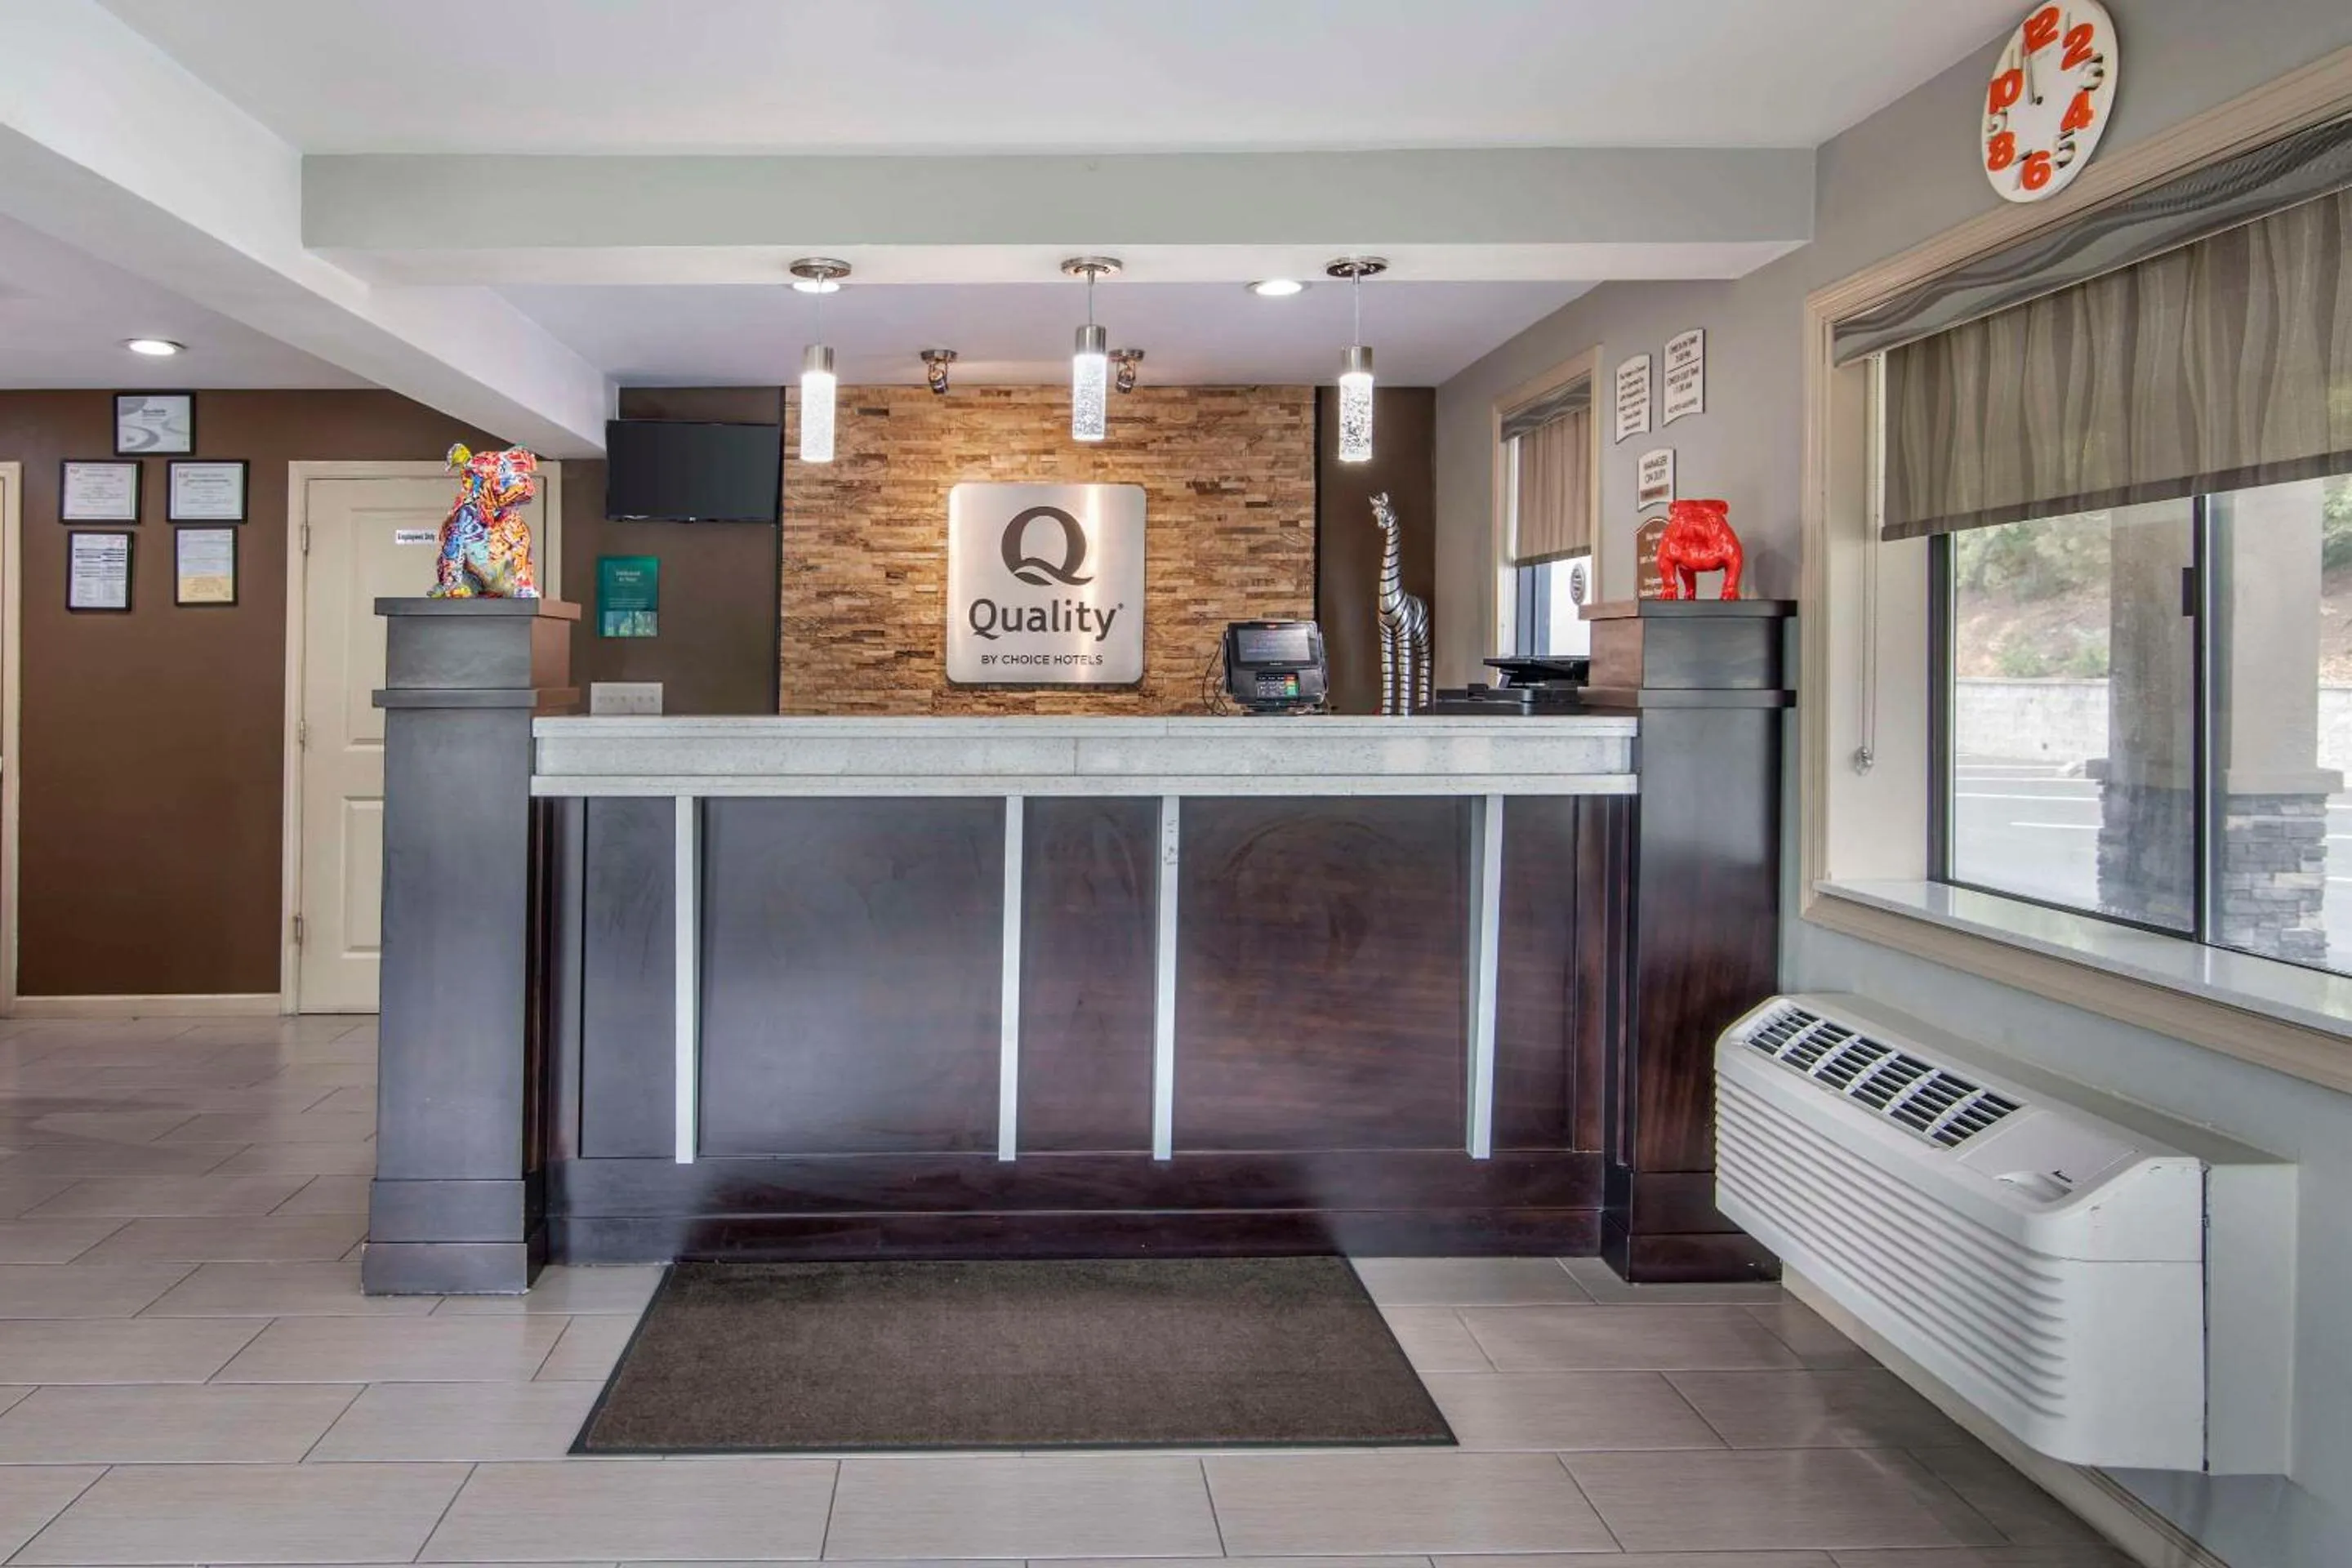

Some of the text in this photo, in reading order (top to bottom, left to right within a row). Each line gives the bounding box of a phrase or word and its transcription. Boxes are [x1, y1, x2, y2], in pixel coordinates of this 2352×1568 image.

[2060, 23, 2094, 71] 2
[2060, 89, 2094, 131] 4
[1988, 131, 2016, 172] 8
[2022, 149, 2051, 190] 6
[969, 599, 1117, 642] Quality
[981, 654, 1103, 666] BY CHOICE HOTELS
